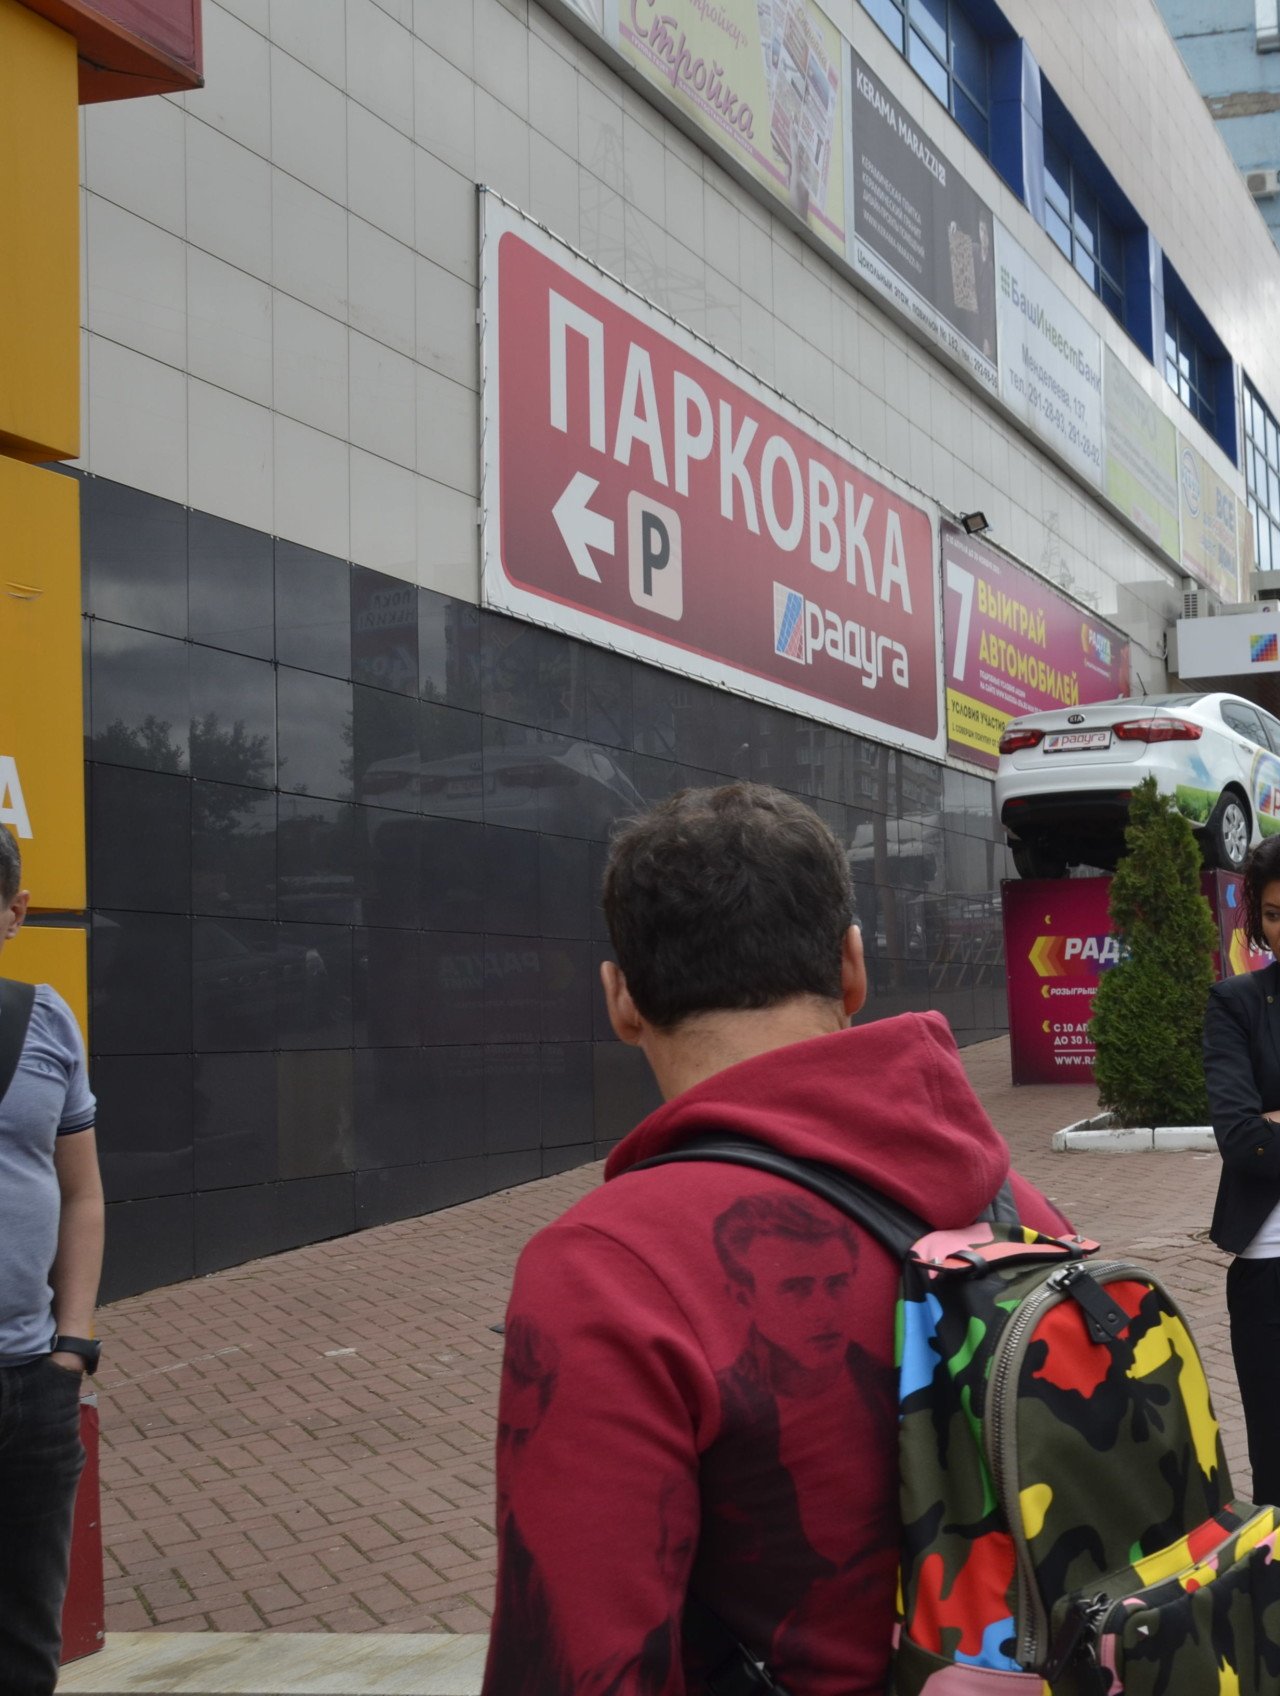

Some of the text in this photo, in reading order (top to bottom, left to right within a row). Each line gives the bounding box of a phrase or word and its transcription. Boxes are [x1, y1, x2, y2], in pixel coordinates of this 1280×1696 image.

[630, 0, 754, 139] Стройка
[856, 67, 938, 178] KERAMA MARAZZI
[1011, 279, 1101, 396] БашИнвестБанк
[548, 287, 913, 615] ПАРКОВКА
[641, 509, 671, 597] Р
[805, 602, 909, 690] радуга
[946, 559, 975, 682] 7
[977, 577, 1046, 649] ВЫИГРАЙ
[978, 629, 1079, 707] АВТОМОБИЛЕЙ
[951, 699, 980, 723] УСЛОВИЯ
[1061, 733, 1106, 746] радуга
[1069, 715, 1083, 723] KIA
[1053, 1023, 1061, 1033] С
[1054, 1035, 1068, 1046] ДО
[1071, 1035, 1082, 1045] 30
